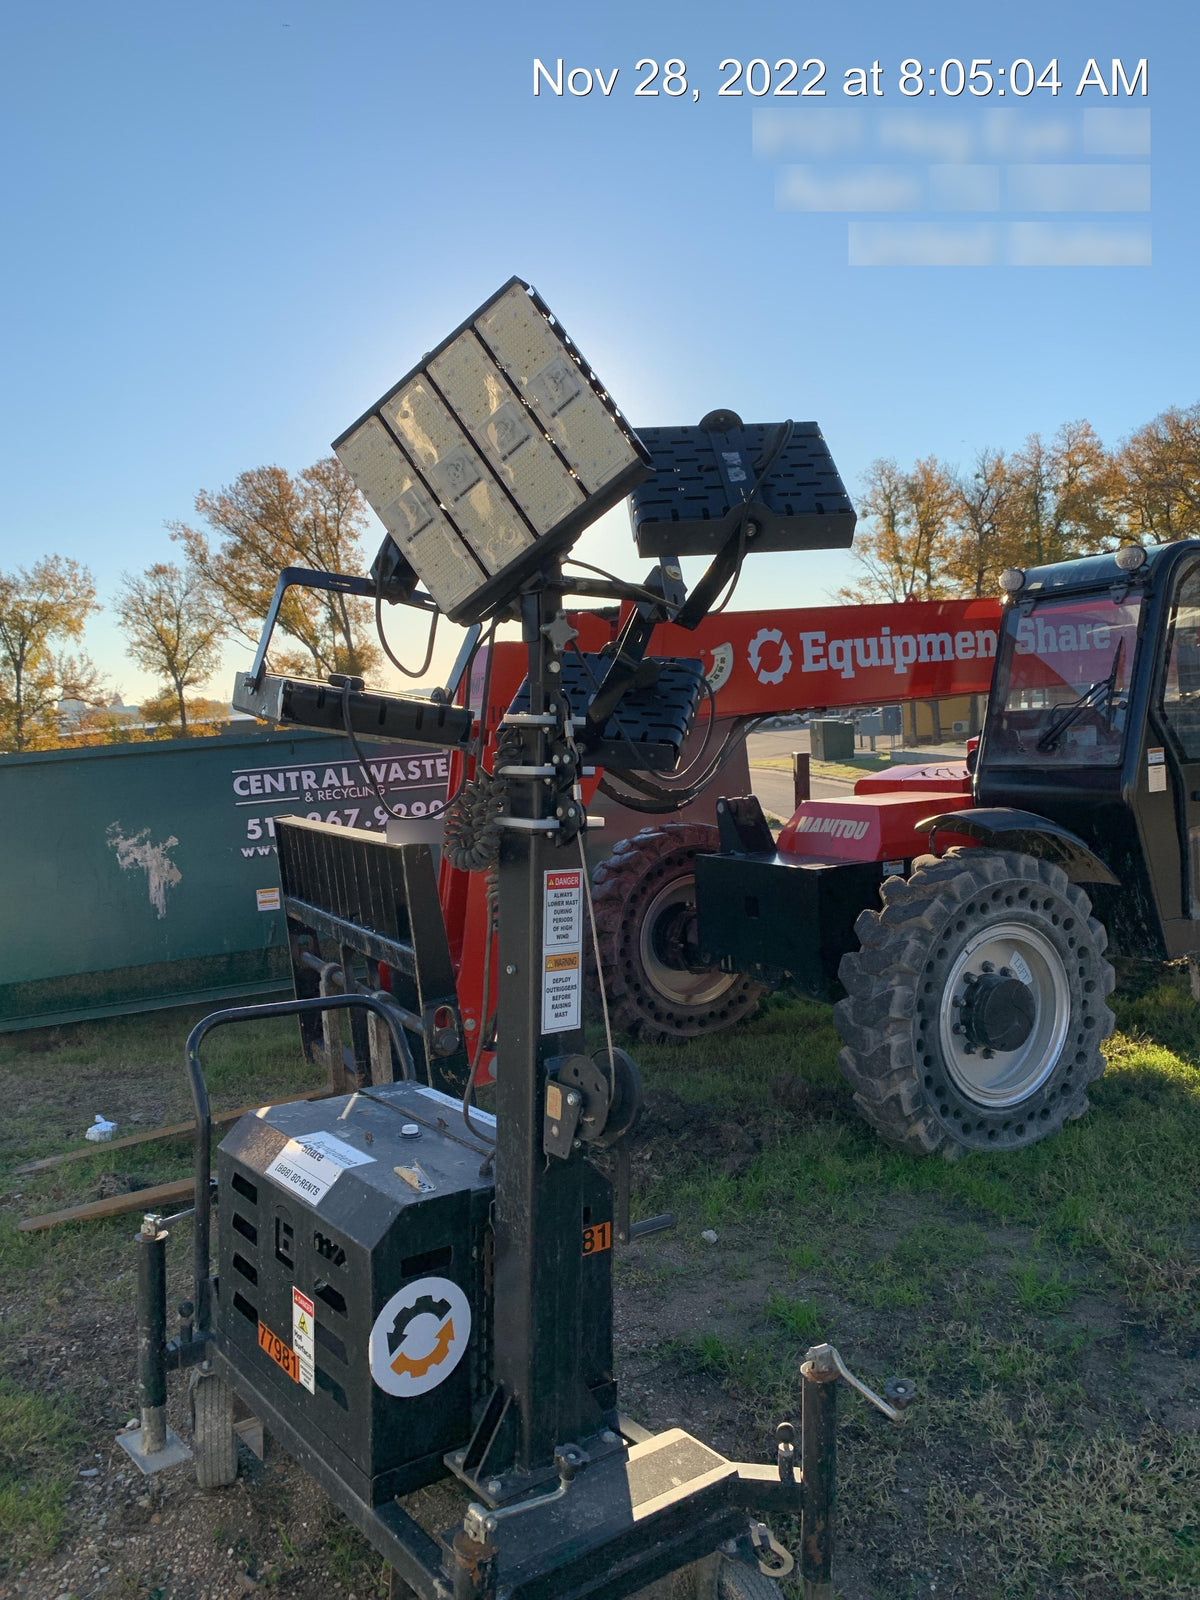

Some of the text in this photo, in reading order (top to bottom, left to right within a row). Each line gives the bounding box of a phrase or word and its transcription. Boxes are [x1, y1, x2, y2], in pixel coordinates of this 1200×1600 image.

[799, 617, 1112, 679] Equipmen Share
[233, 758, 449, 796] CENTRAL WASTE
[304, 784, 386, 803] & RECYCLING
[795, 815, 870, 841] MANITOU
[554, 876, 579, 886] DANGER
[553, 891, 573, 899] ALWAYS
[547, 900, 565, 908] LOWER
[552, 916, 574, 924] PERIODS
[554, 956, 577, 968] WARNING
[1014, 958, 1029, 980] LEFT
[552, 976, 572, 984] DEPLOY
[546, 984, 578, 994] OUTRIGGERS
[551, 993, 571, 1002] BEFORE
[551, 1001, 572, 1010] RAISING
[554, 1010, 569, 1018] MAST
[274, 1162, 320, 1197] (888) 80-RENTS
[259, 1323, 296, 1379] 77981
